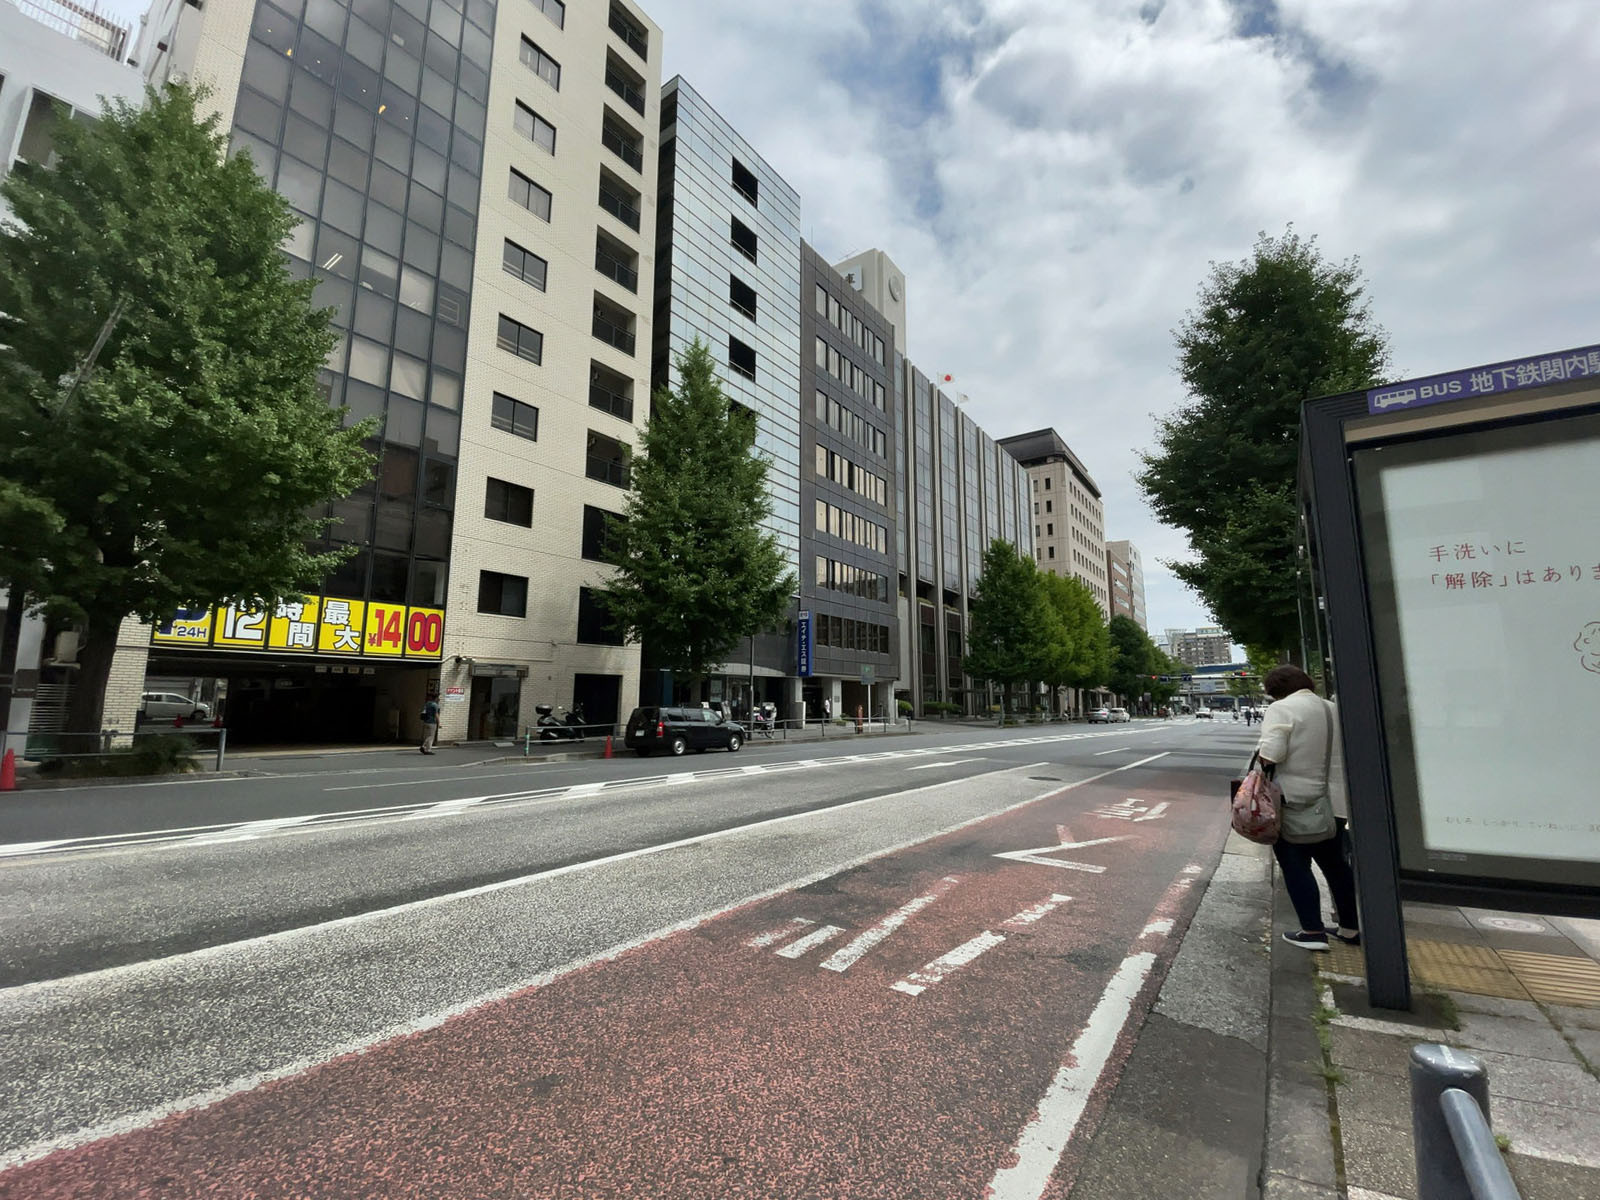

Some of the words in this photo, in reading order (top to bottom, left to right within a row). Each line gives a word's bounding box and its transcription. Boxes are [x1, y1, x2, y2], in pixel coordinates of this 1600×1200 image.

[1420, 381, 1462, 399] BUS
[1429, 541, 1526, 562] 手洗いに
[177, 626, 207, 638] 24H
